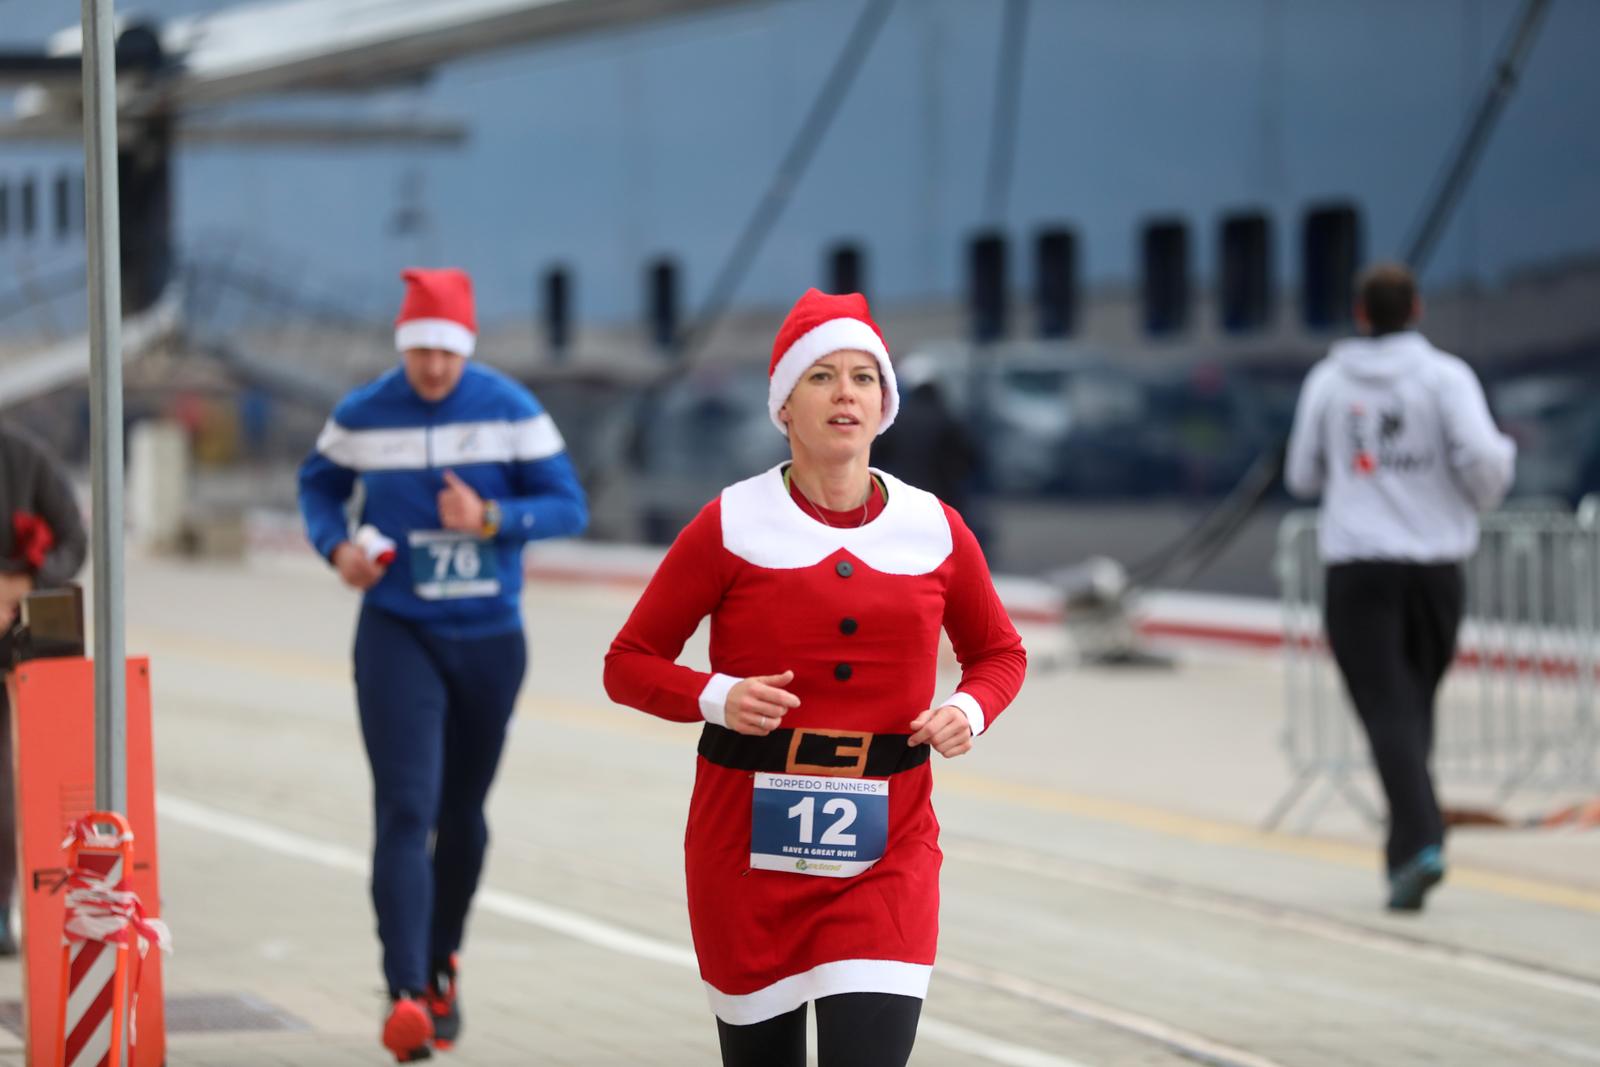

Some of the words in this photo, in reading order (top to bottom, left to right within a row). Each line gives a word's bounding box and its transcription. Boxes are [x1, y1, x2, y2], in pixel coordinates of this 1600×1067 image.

[768, 778, 822, 790] TORPEDO
[825, 781, 877, 793] RUNNERS
[788, 796, 858, 846] 12
[782, 846, 802, 855] HAVE
[811, 849, 835, 857] GREAT
[837, 850, 857, 858] RUN!
